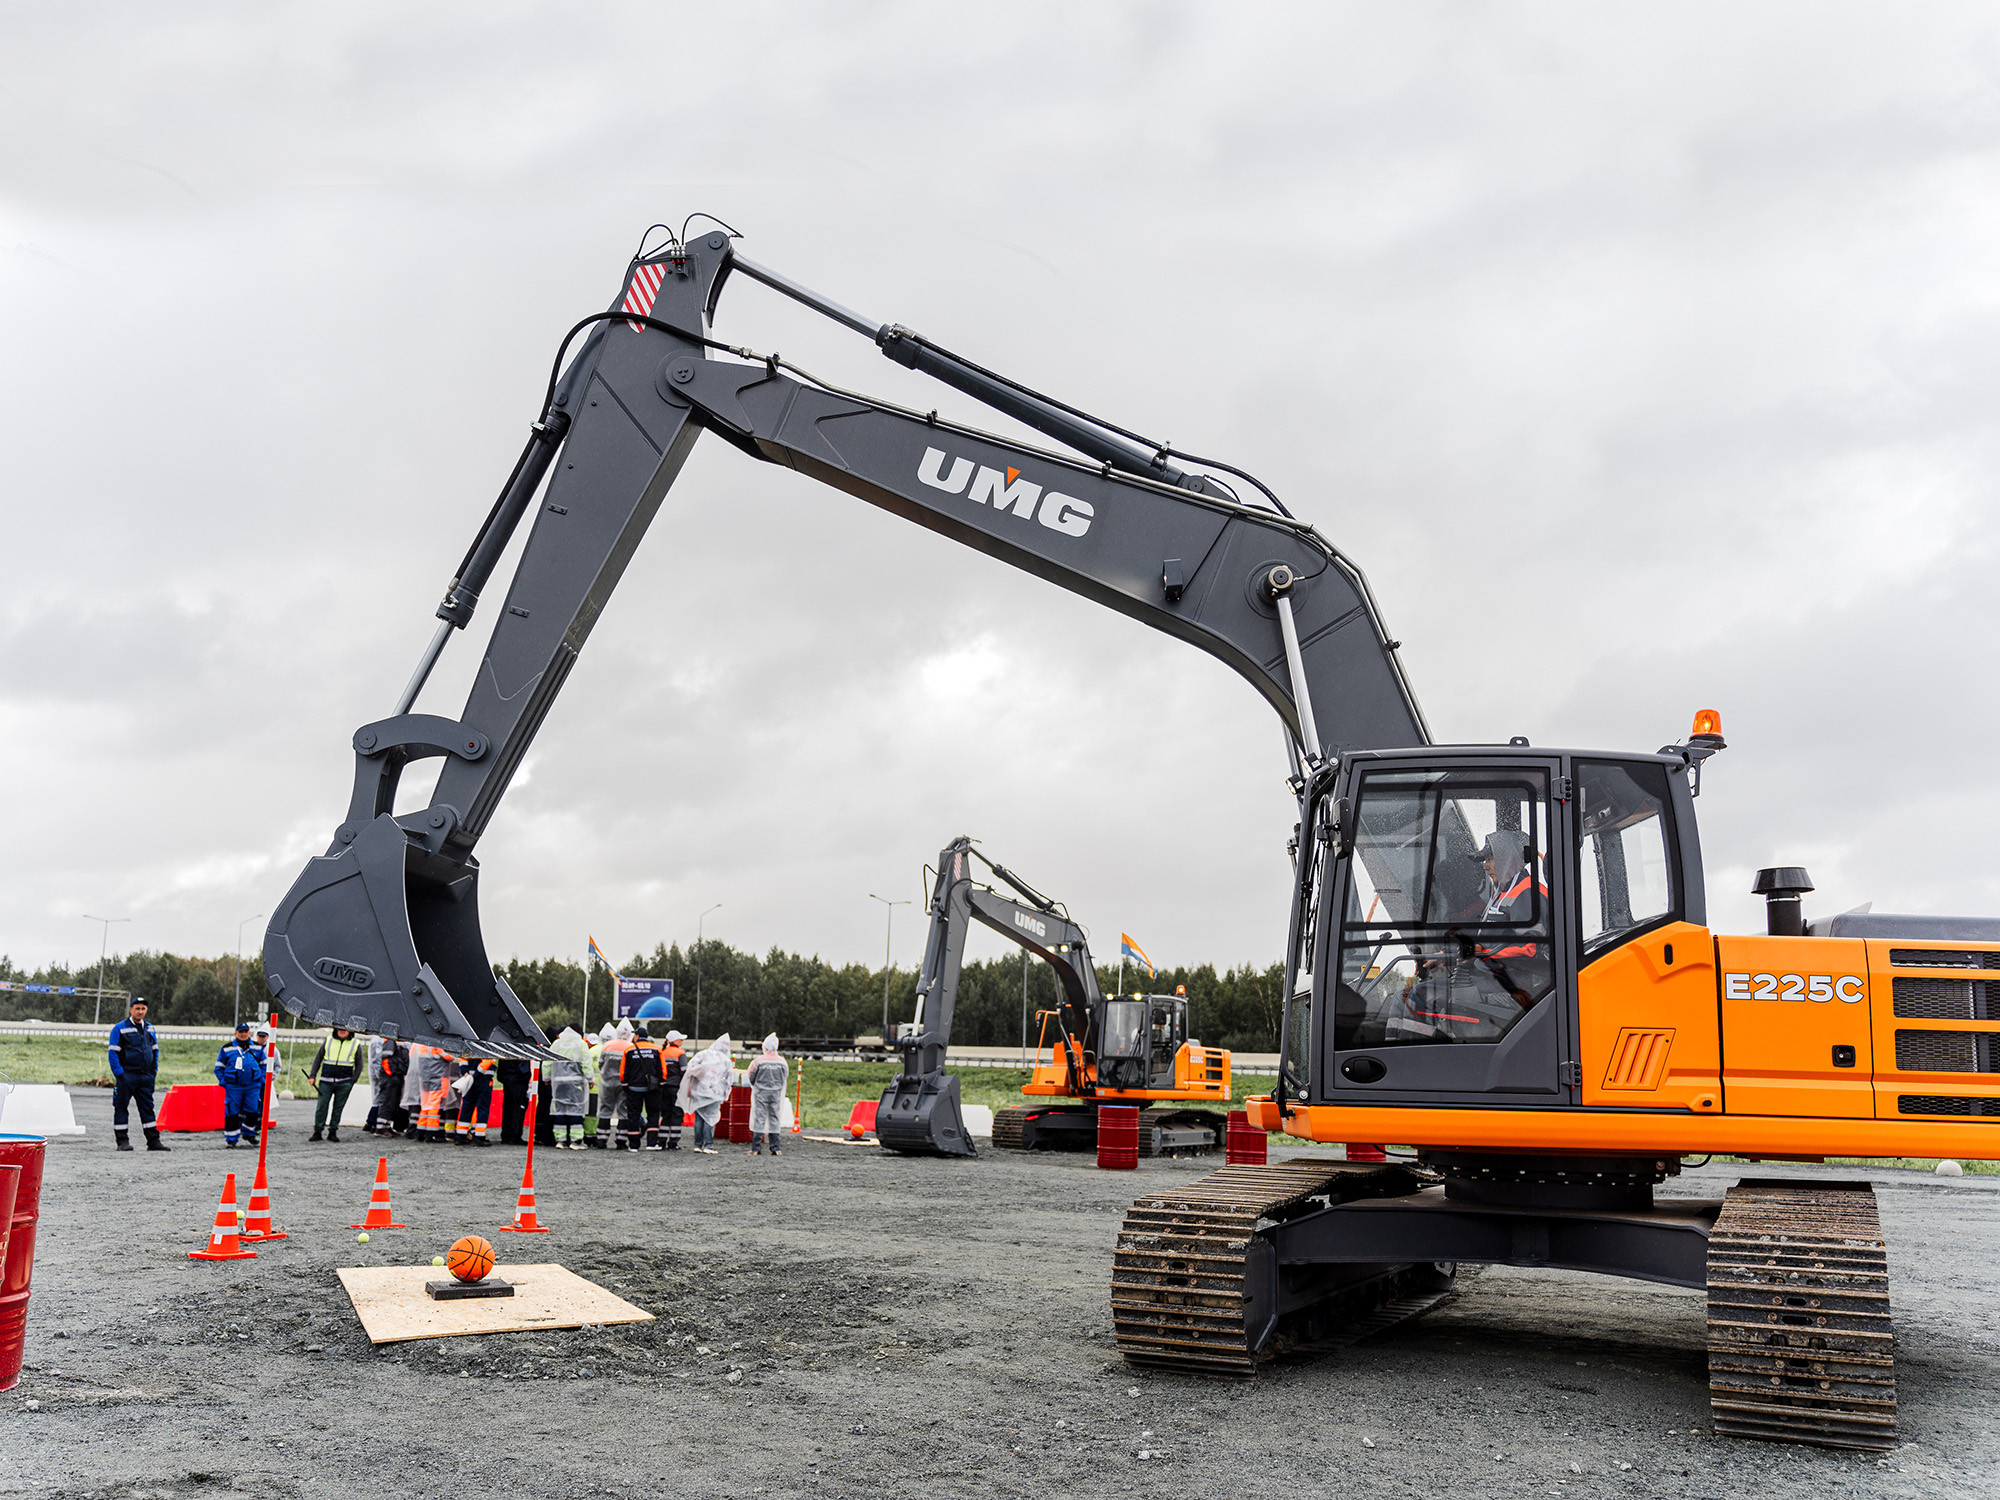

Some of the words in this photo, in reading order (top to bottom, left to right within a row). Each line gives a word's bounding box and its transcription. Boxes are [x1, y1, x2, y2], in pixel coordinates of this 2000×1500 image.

[917, 446, 1095, 538] UMG
[1014, 910, 1046, 938] UMG
[320, 962, 368, 984] UMG
[1725, 972, 1865, 1004] E225C
